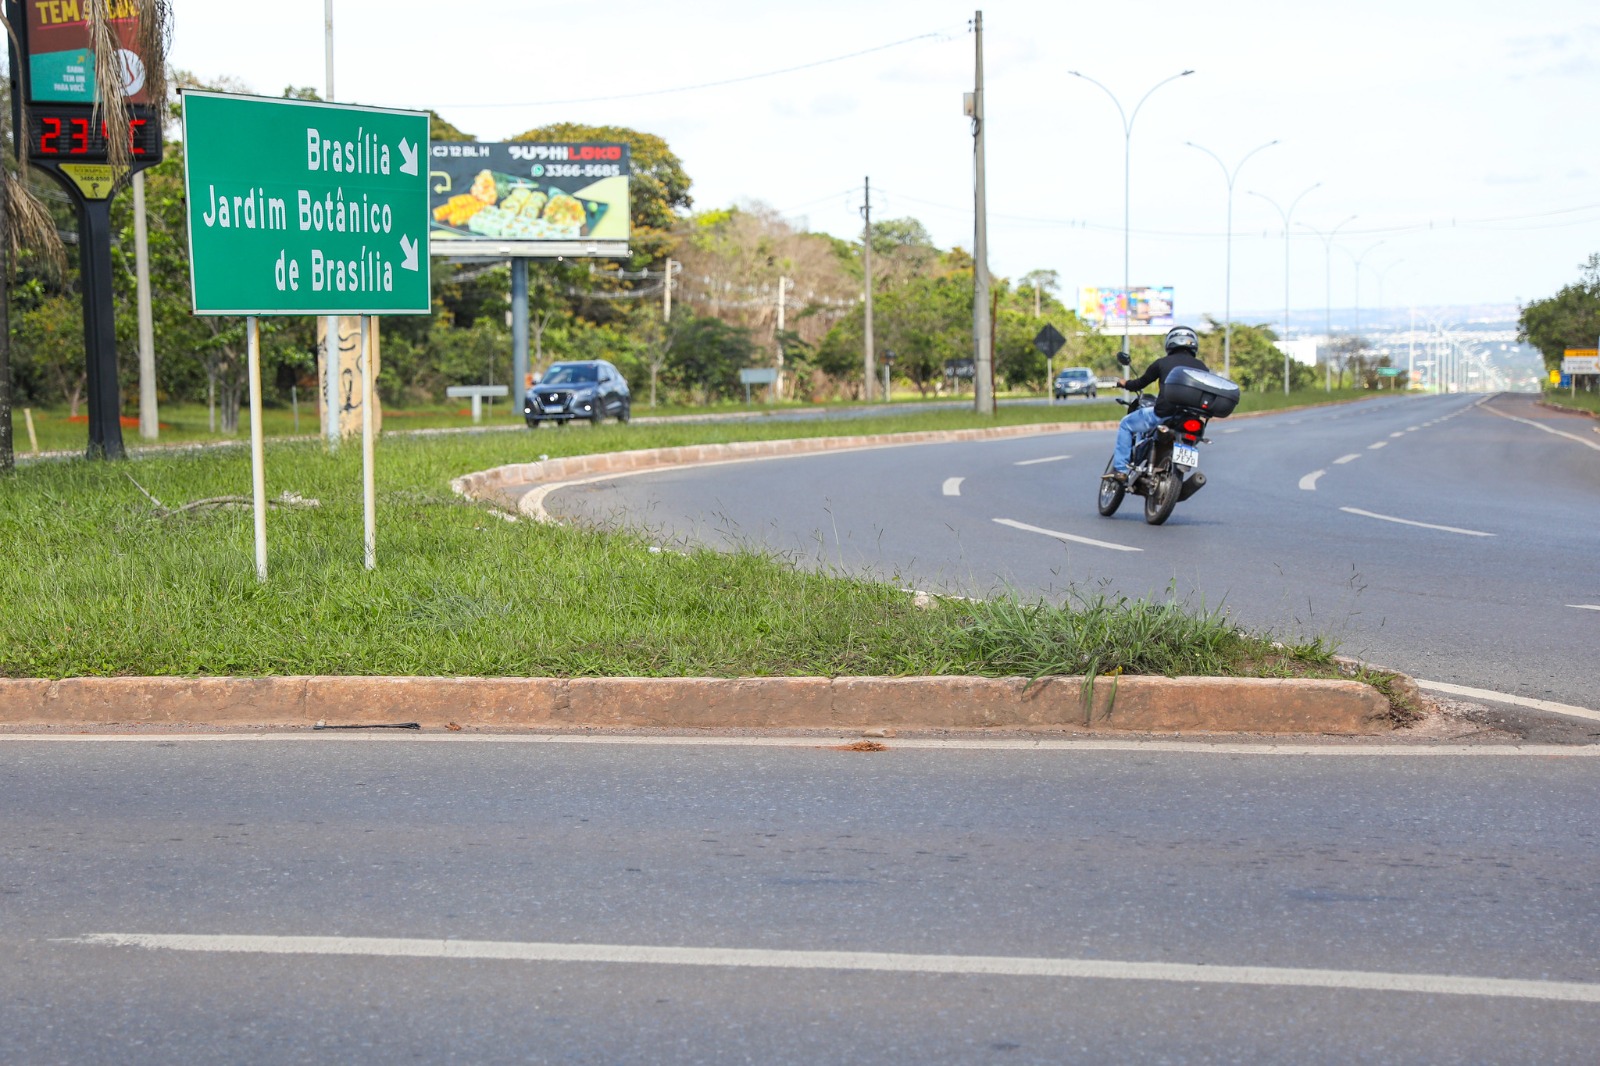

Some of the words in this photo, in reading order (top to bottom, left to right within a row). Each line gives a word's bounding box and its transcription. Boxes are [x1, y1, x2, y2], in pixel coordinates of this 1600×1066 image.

[35, 0, 80, 24] TEM
[307, 126, 390, 175] Brasília
[203, 184, 287, 230] Jardim
[298, 186, 392, 233] Botânico
[275, 248, 299, 291] de
[311, 245, 393, 291] Brasília
